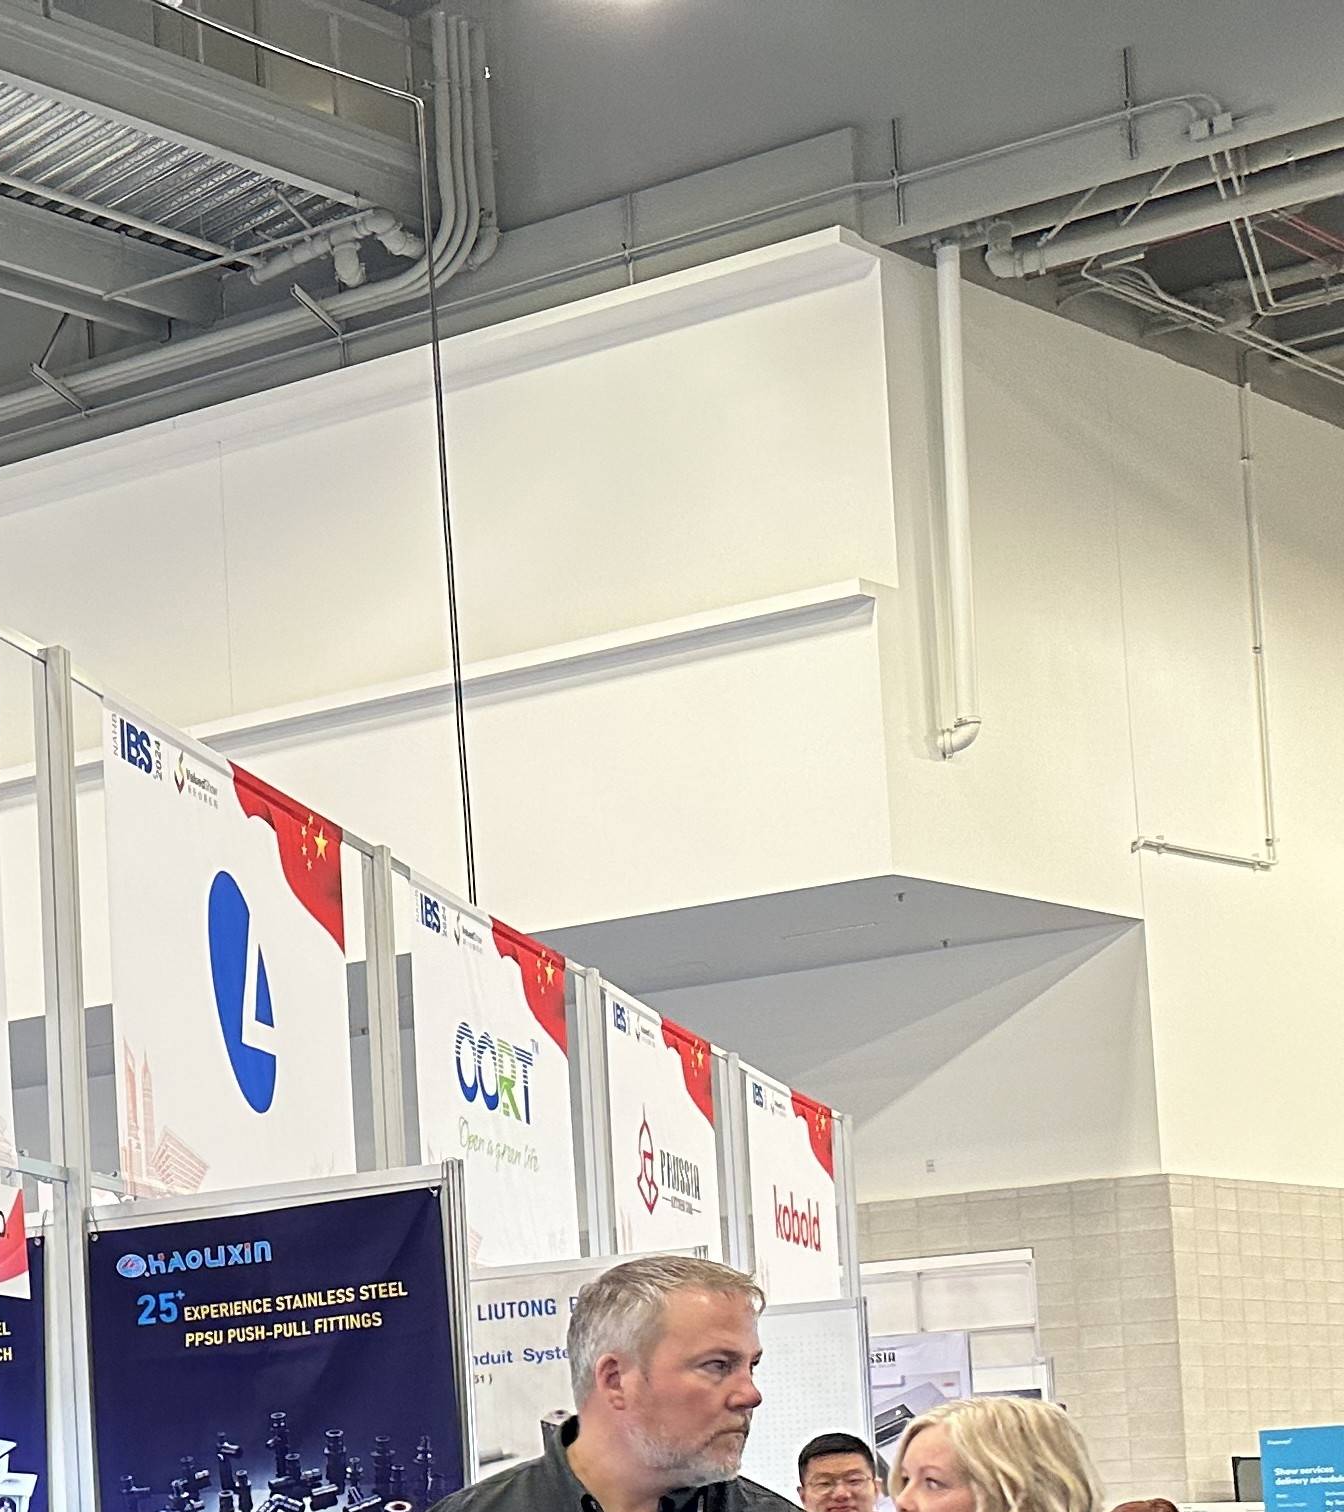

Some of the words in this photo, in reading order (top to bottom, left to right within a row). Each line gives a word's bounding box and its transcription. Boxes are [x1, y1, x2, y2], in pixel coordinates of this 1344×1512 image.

[119, 717, 153, 775] IBS
[419, 892, 441, 934] IBS
[772, 1184, 823, 1252] kobold
[184, 1297, 273, 1322] EXPERIENCE
[275, 1286, 356, 1312] STAINLESS
[358, 1280, 409, 1299] STEEL
[477, 1298, 557, 1322] LIUTONG
[184, 1329, 224, 1348] PPSU
[226, 1320, 311, 1344] PUSH-PULL
[313, 1311, 383, 1335] FITTINGS
[523, 1346, 570, 1365] Syste
